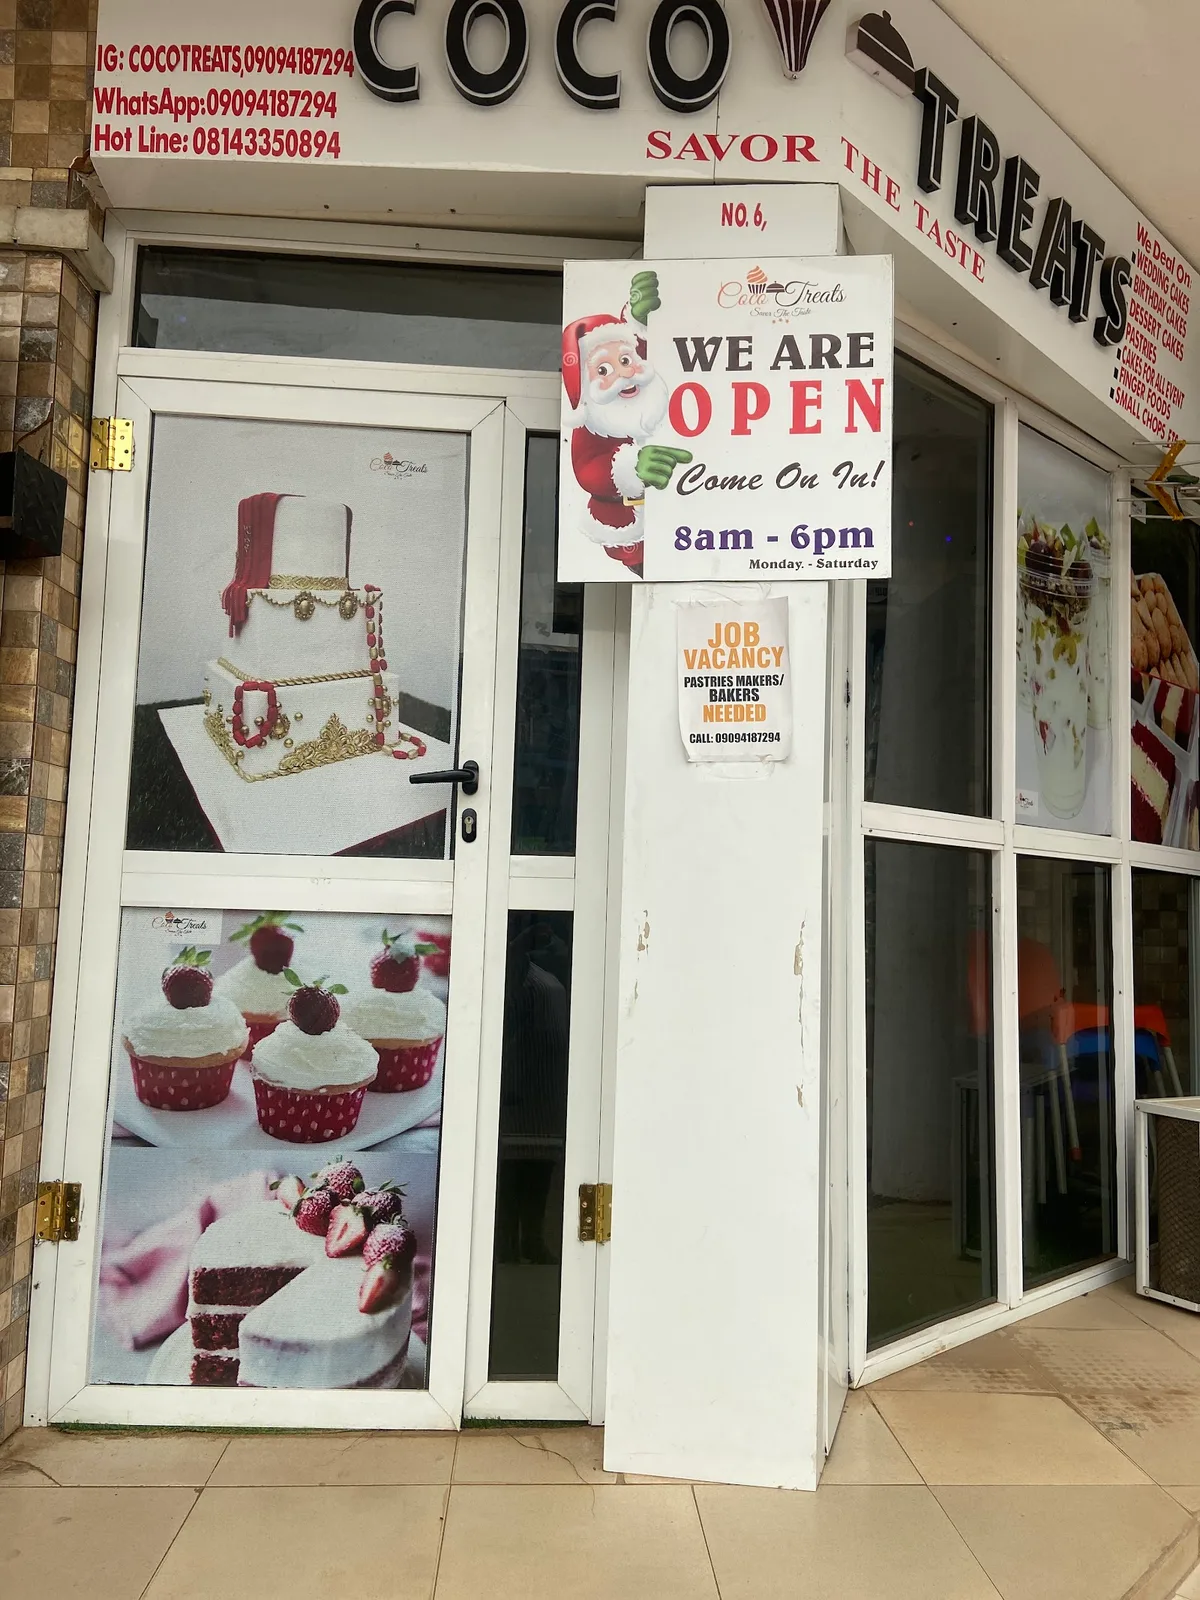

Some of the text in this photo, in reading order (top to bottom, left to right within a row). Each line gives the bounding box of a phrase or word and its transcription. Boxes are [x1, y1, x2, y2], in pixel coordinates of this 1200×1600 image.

[97, 44, 354, 78] IG: COCOTREATS,09094187294
[353, 0, 731, 113] COCO
[94, 87, 337, 122] WhatsApp:09094187294
[94, 124, 341, 159] Hot Line: 08143350894
[646, 130, 820, 162] SAVOR
[721, 202, 767, 231] NO. 6,
[841, 137, 986, 284] THE TASTE
[913, 66, 1133, 347] TREATS
[1136, 221, 1193, 289] We Deal On:
[717, 280, 847, 309] Coco Treats
[1136, 249, 1190, 315] WEDDING CAKES
[1133, 274, 1187, 338] BIRTHDAY CAKES
[1125, 322, 1157, 364] PASTRIES
[1129, 298, 1184, 361] DESSERT CAKES
[673, 333, 874, 372] WE ARE
[1118, 366, 1171, 420] FINGER FOODS
[1121, 345, 1185, 409] CAKES FOR ALL EVENT
[668, 378, 885, 438] OPEN
[1115, 386, 1140, 420] SMALL
[1142, 408, 1166, 439] CHOPS
[676, 460, 886, 496] Come On In!
[673, 524, 875, 555] 8am - 6pm
[749, 559, 804, 570] Monday.
[816, 557, 879, 570] Saturday
[708, 622, 760, 648] JOB
[683, 646, 784, 670] VACANCY
[684, 673, 785, 688] PASTRIES MAKERS/
[709, 687, 760, 702] BAKERS
[703, 704, 766, 723] NEEDED
[689, 732, 781, 744] CALL: 09094187294
